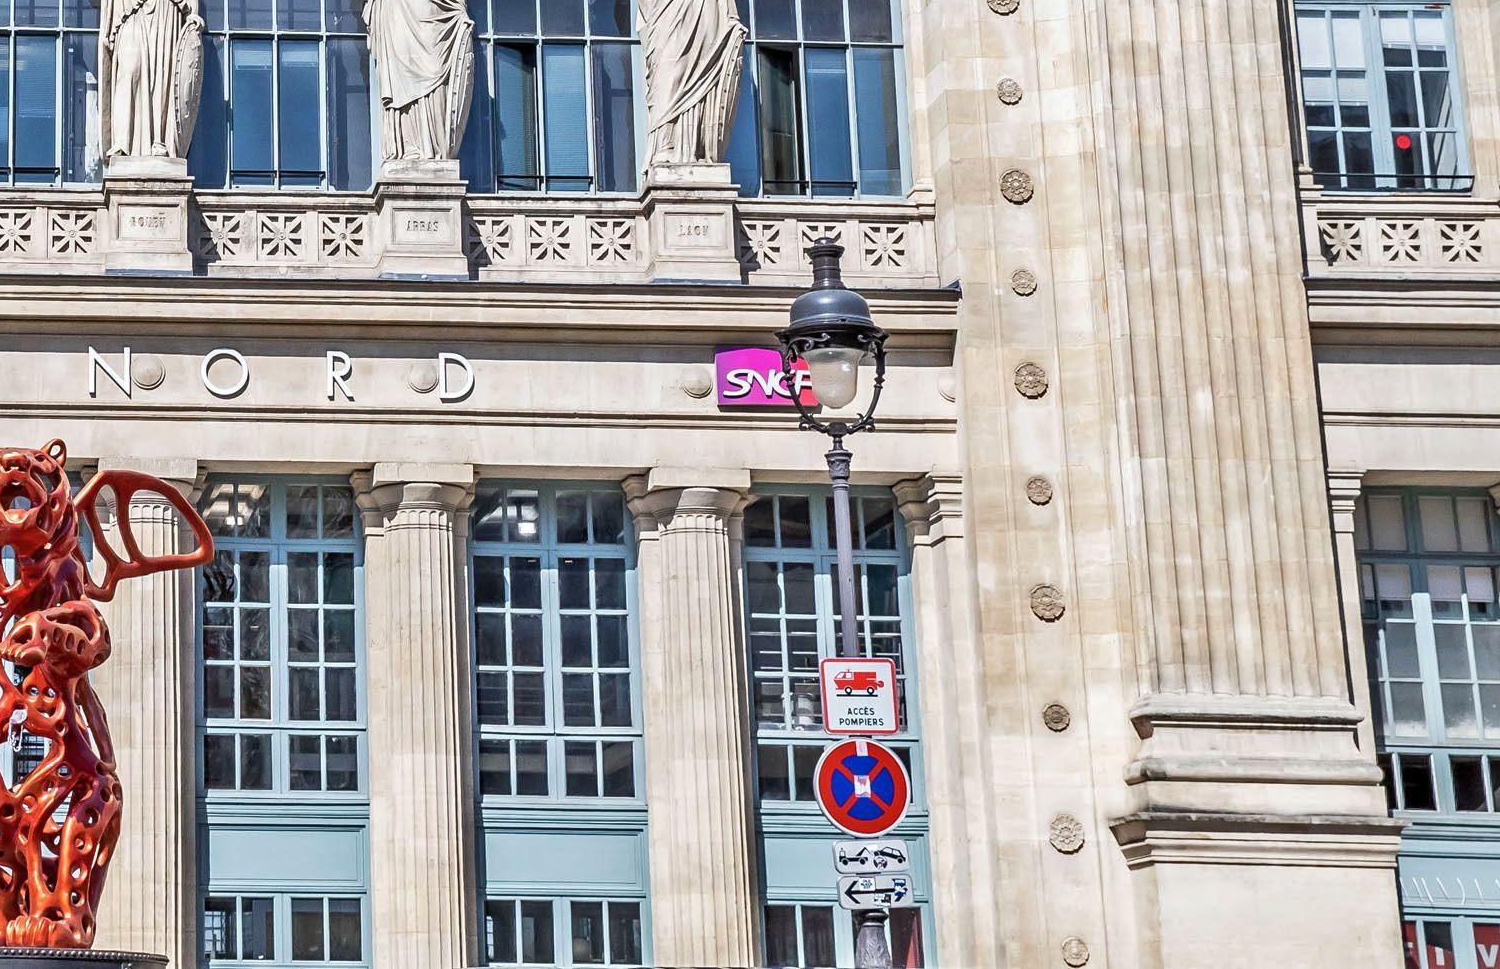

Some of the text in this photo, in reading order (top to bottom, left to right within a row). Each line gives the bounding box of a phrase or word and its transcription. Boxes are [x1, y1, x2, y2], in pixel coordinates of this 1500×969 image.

[88, 346, 475, 401] NORD
[723, 368, 812, 397] SNCF
[847, 705, 875, 716] ACCÈS
[839, 717, 884, 727] POMPIERS
